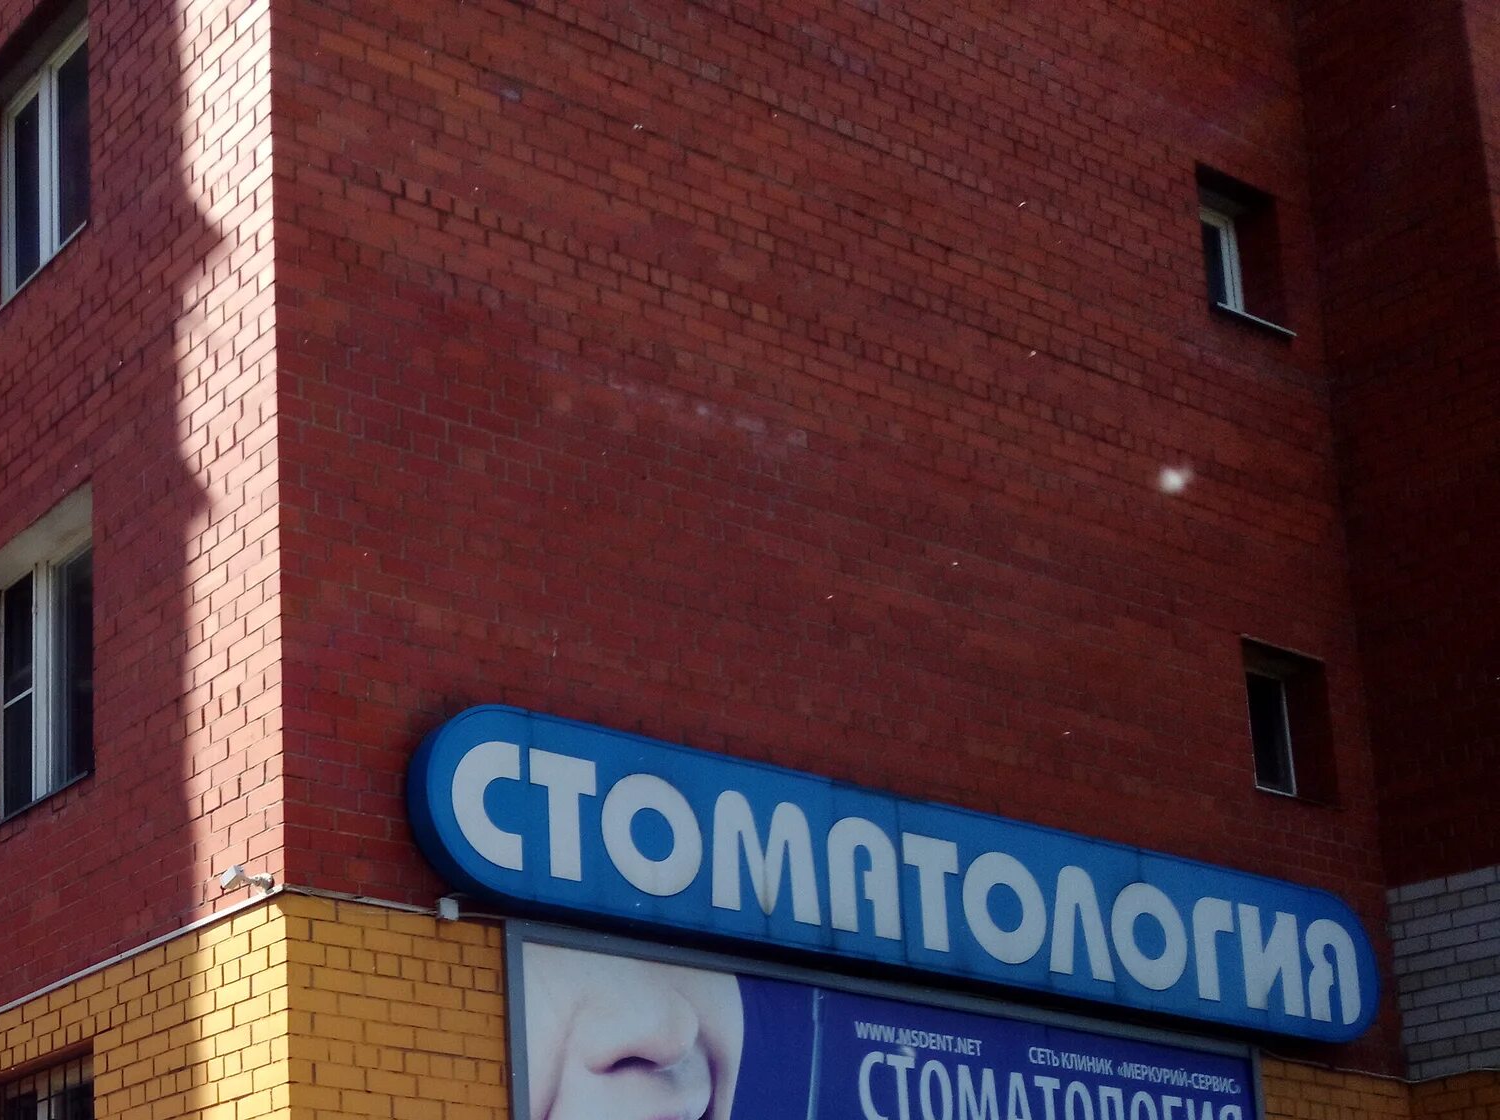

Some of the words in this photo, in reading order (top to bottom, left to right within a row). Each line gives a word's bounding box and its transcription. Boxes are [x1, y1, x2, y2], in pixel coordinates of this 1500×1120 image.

[451, 740, 1362, 1025] СТОМАТОЛОГИЯ
[854, 1021, 982, 1057] WWW.MSDENT.NET
[1029, 1047, 1060, 1067] СЕТЬ
[1061, 1052, 1113, 1076] КЛИНИК
